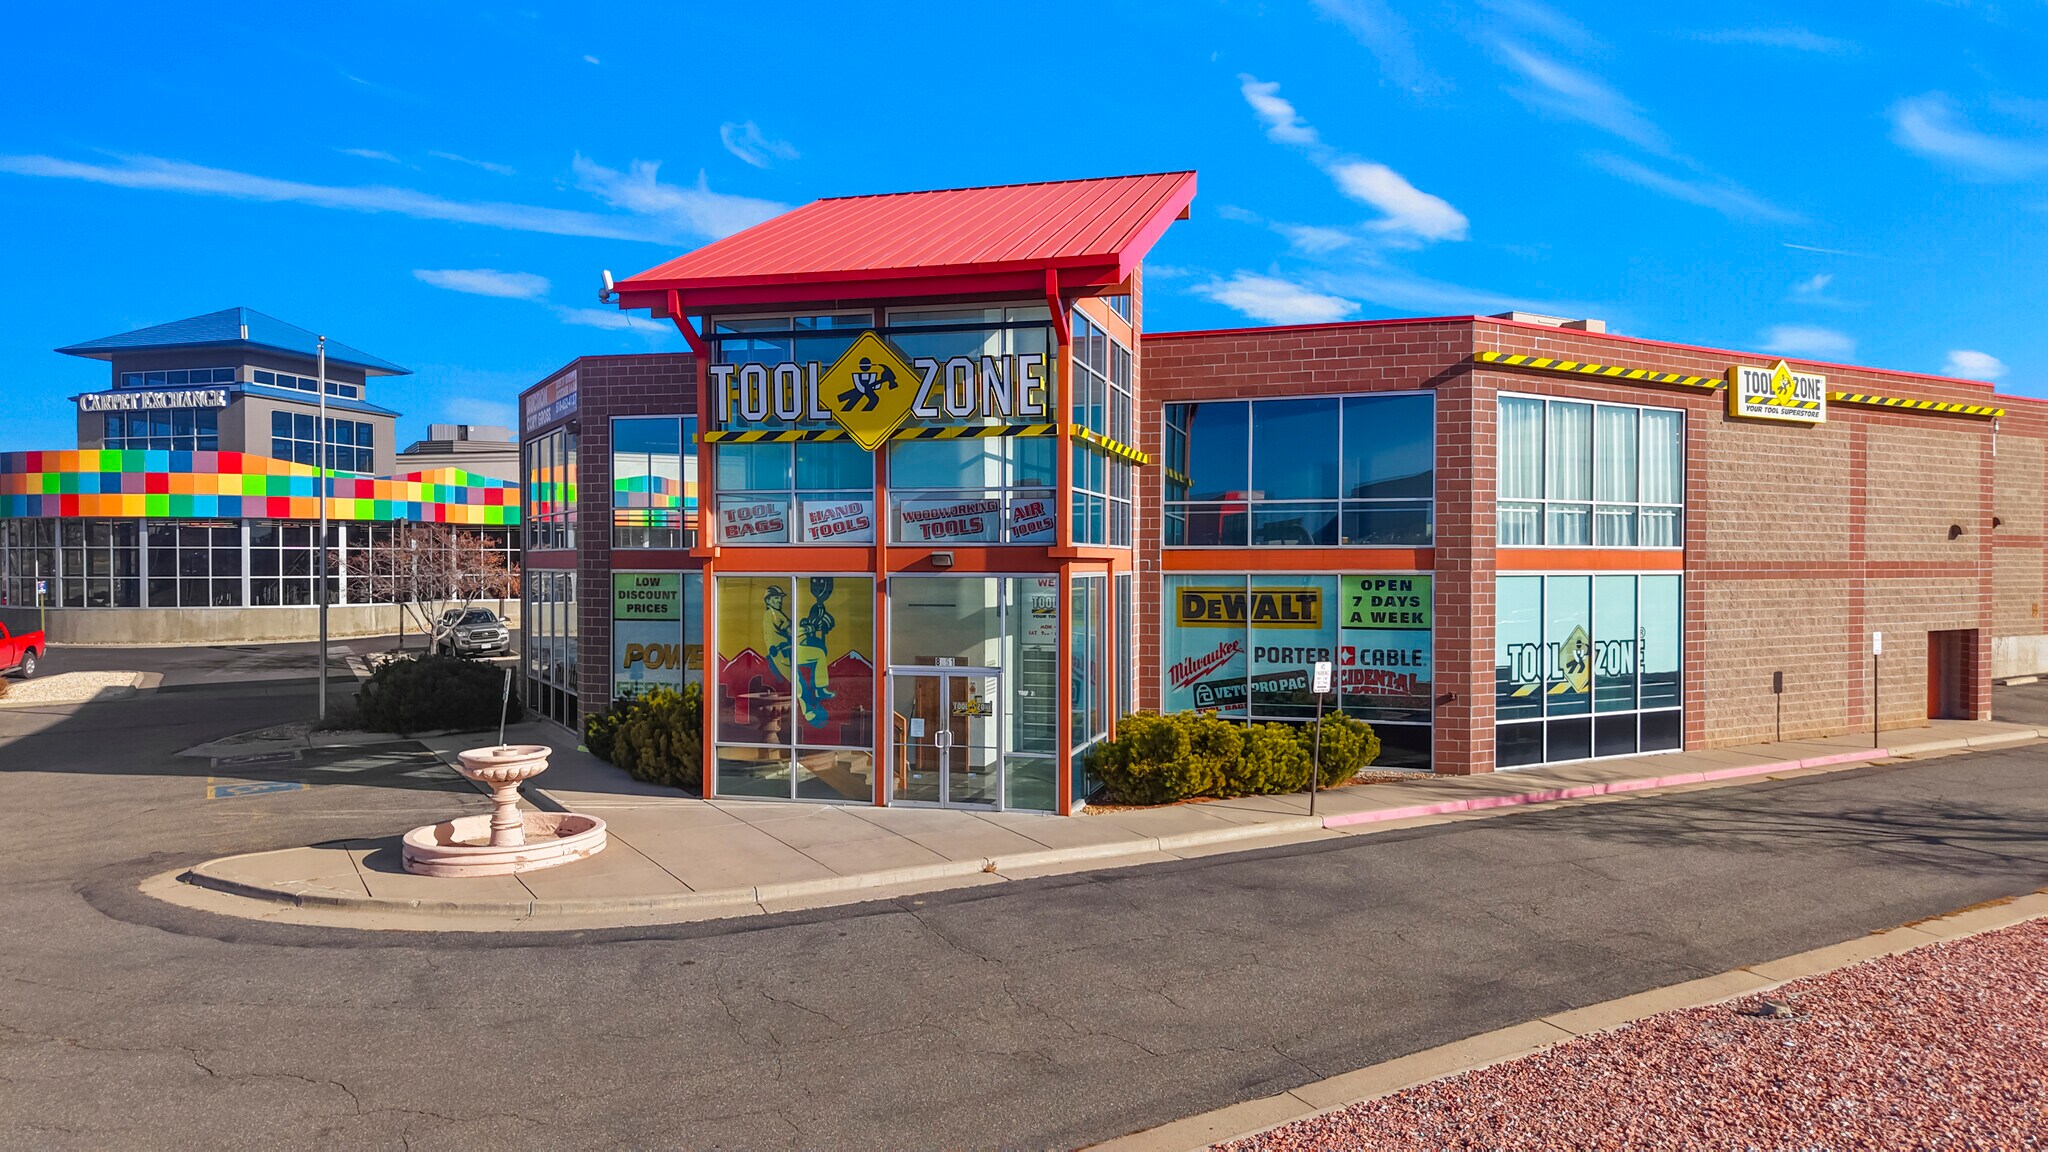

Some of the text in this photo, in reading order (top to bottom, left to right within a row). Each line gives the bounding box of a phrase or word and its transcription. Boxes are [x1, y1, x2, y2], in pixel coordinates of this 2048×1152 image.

[708, 352, 1046, 423] TOOL ZONE
[1744, 370, 1820, 400] TOOL ZONE
[80, 390, 226, 412] CARPET EXCHANGE
[1746, 404, 1819, 418] YOUR TOOL SUPERSTORE
[538, 406, 551, 426] GROSS
[723, 503, 781, 522] TOOL
[808, 502, 863, 525] HAND
[902, 501, 998, 523] WOODWORKING
[1013, 501, 1045, 523] AIR
[725, 518, 783, 538] BAGS
[808, 516, 869, 540] TOOLS
[919, 517, 984, 540] TOOLS
[1010, 517, 1054, 538] TOOLS
[635, 577, 661, 587] LOW
[1037, 578, 1057, 587] WE
[1361, 579, 1412, 591] OPEN
[618, 590, 677, 600] DISCOUNT
[1352, 596, 1420, 607] 7 DAYS
[626, 603, 669, 613] PRICES
[1350, 612, 1424, 623] A WEEK
[1168, 639, 1243, 686] Milwaukee
[1254, 646, 1423, 667] PORTER CABLE
[1507, 641, 1566, 683] TOOL
[1213, 684, 1248, 699] VETO
[1279, 676, 1306, 691] PAC
[1314, 669, 1417, 692] CCIDENTAL
